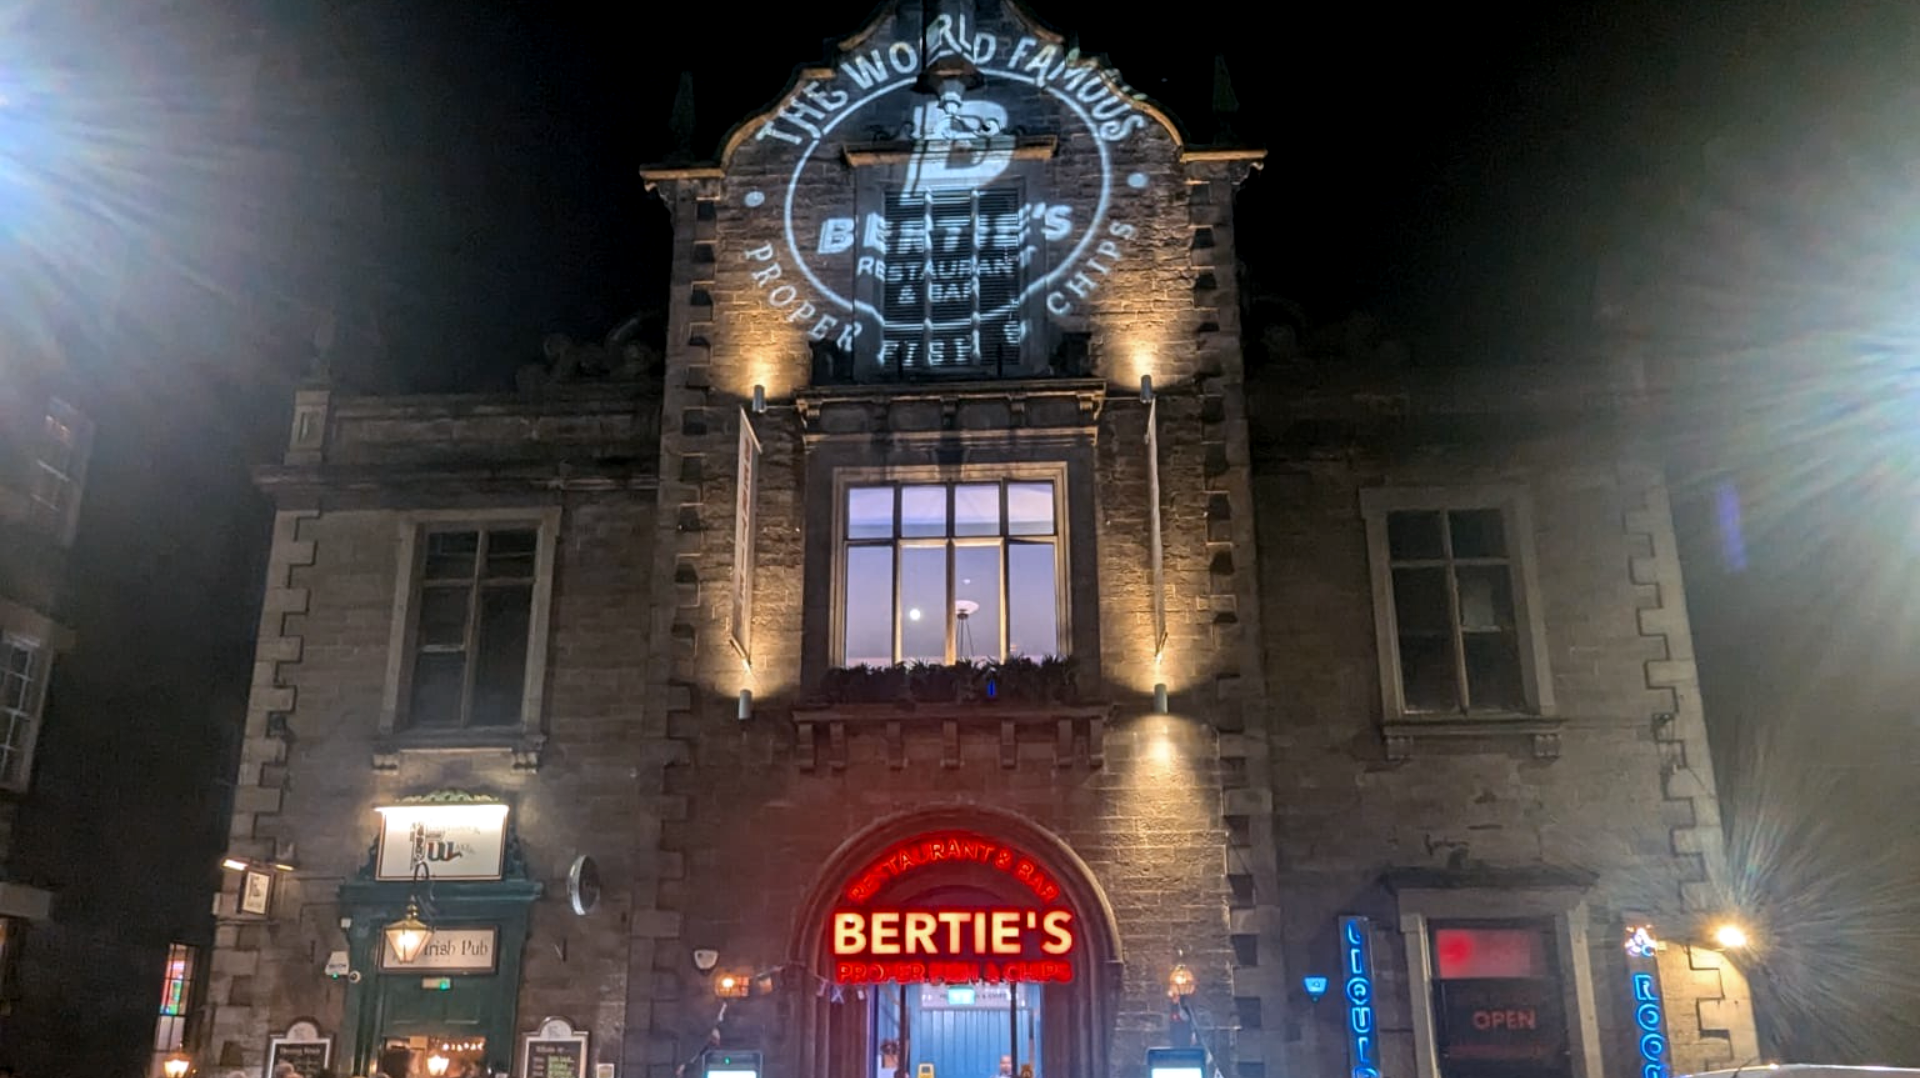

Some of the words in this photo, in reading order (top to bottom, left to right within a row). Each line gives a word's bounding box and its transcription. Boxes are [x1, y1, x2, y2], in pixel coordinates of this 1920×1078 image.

[755, 80, 849, 145] THE
[839, 13, 997, 90] WORLD
[1008, 36, 1148, 141] FAMOUS
[817, 202, 1073, 256] BERTIE'S
[856, 246, 1037, 282] RESTAURANT
[743, 241, 863, 353] PROPER
[877, 329, 981, 368] FISH
[1046, 220, 1138, 316] CHIPS
[848, 838, 996, 902] RESTAURANT
[1016, 857, 1060, 903] BAR
[424, 939, 456, 957] Irish
[461, 939, 489, 956] Pub
[833, 910, 1074, 955] BERTIE'S
[1472, 1009, 1537, 1030] OPEN
